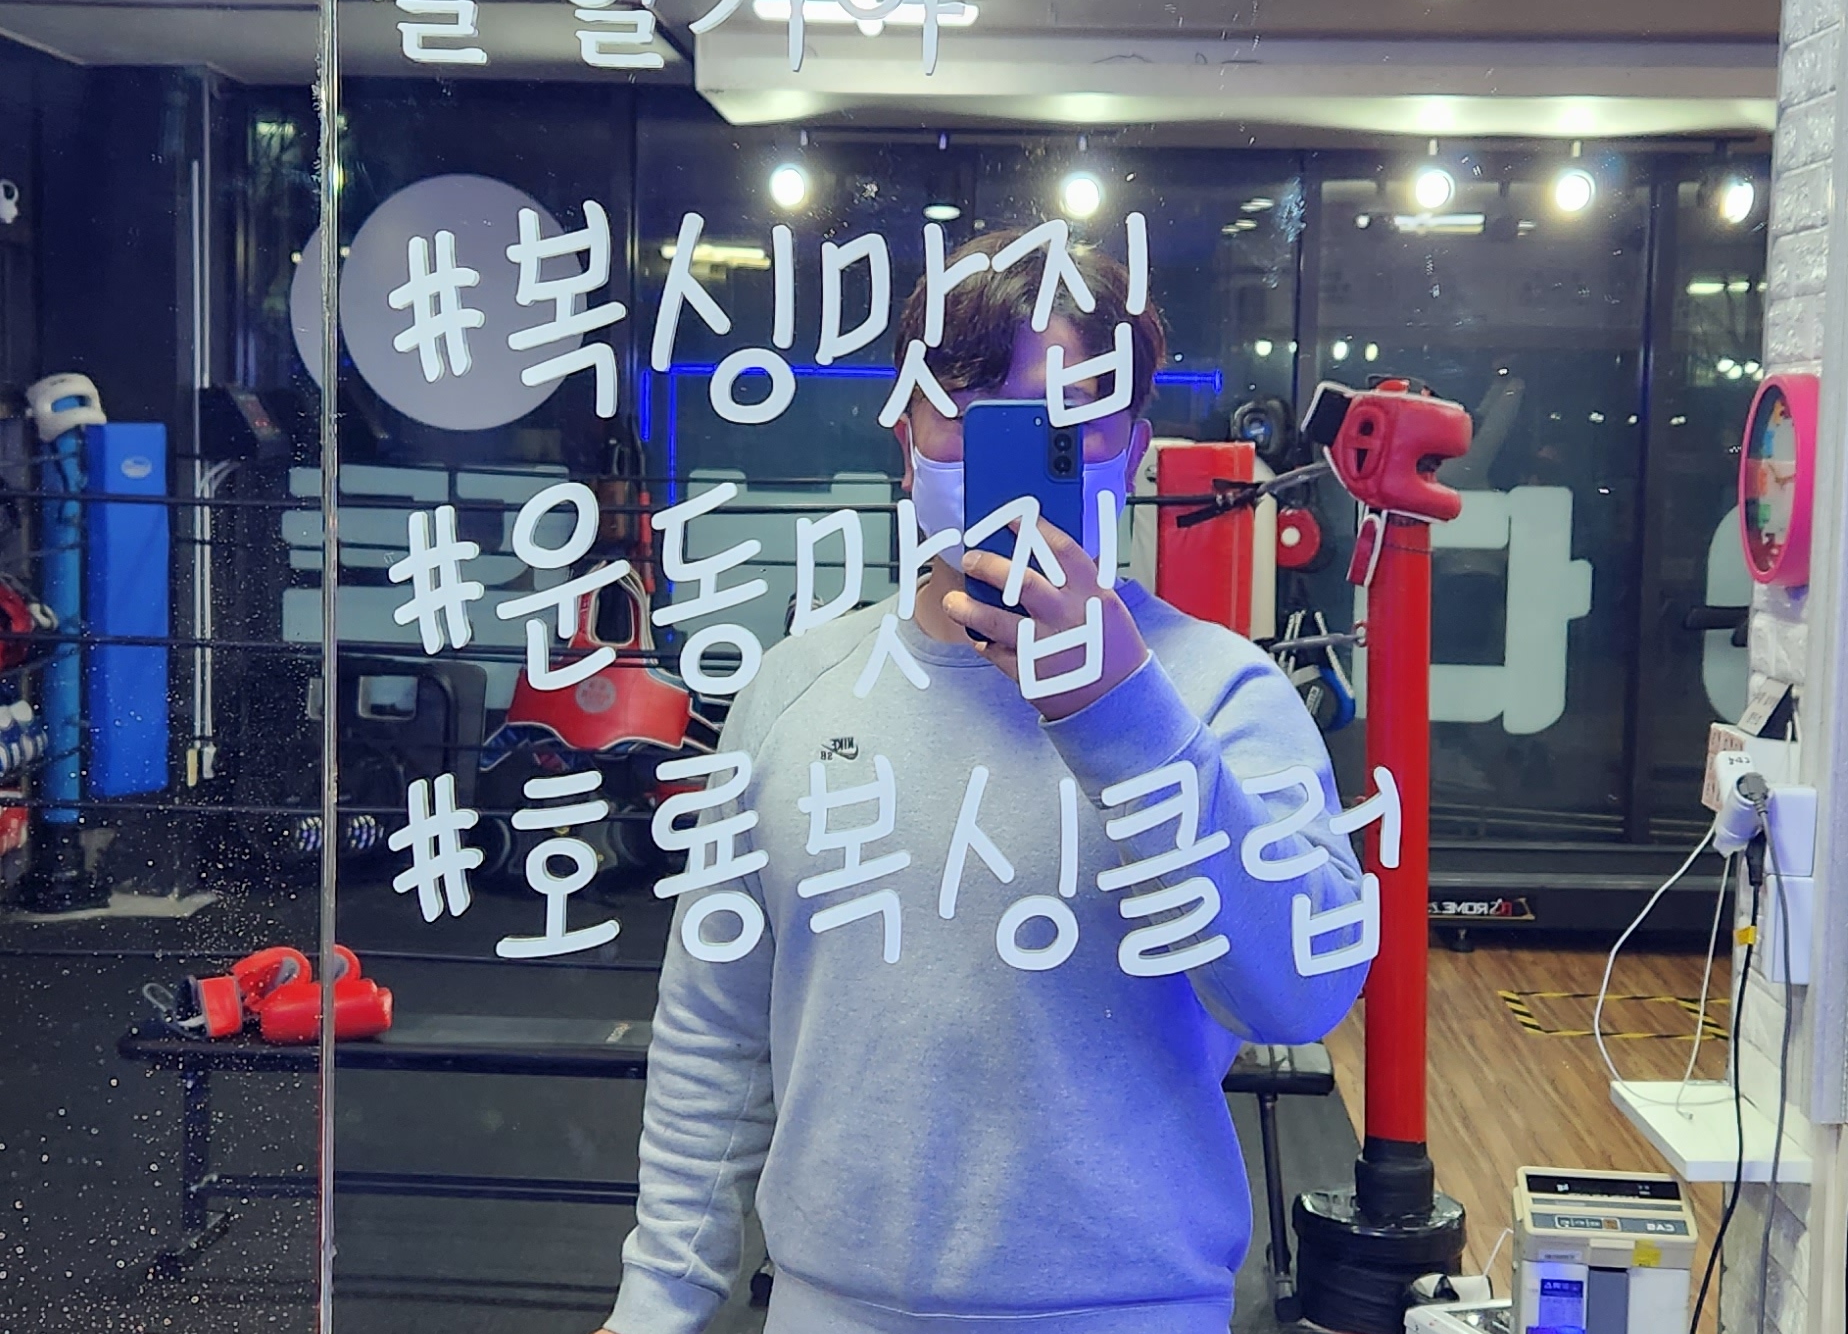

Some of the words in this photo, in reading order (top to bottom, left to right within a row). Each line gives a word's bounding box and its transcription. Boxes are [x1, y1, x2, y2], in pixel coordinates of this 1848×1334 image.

[387, 199, 1150, 429] #복싱맛집
[387, 481, 1120, 702] #운동맛집
[387, 748, 1402, 977] #호룡복싱클럽
